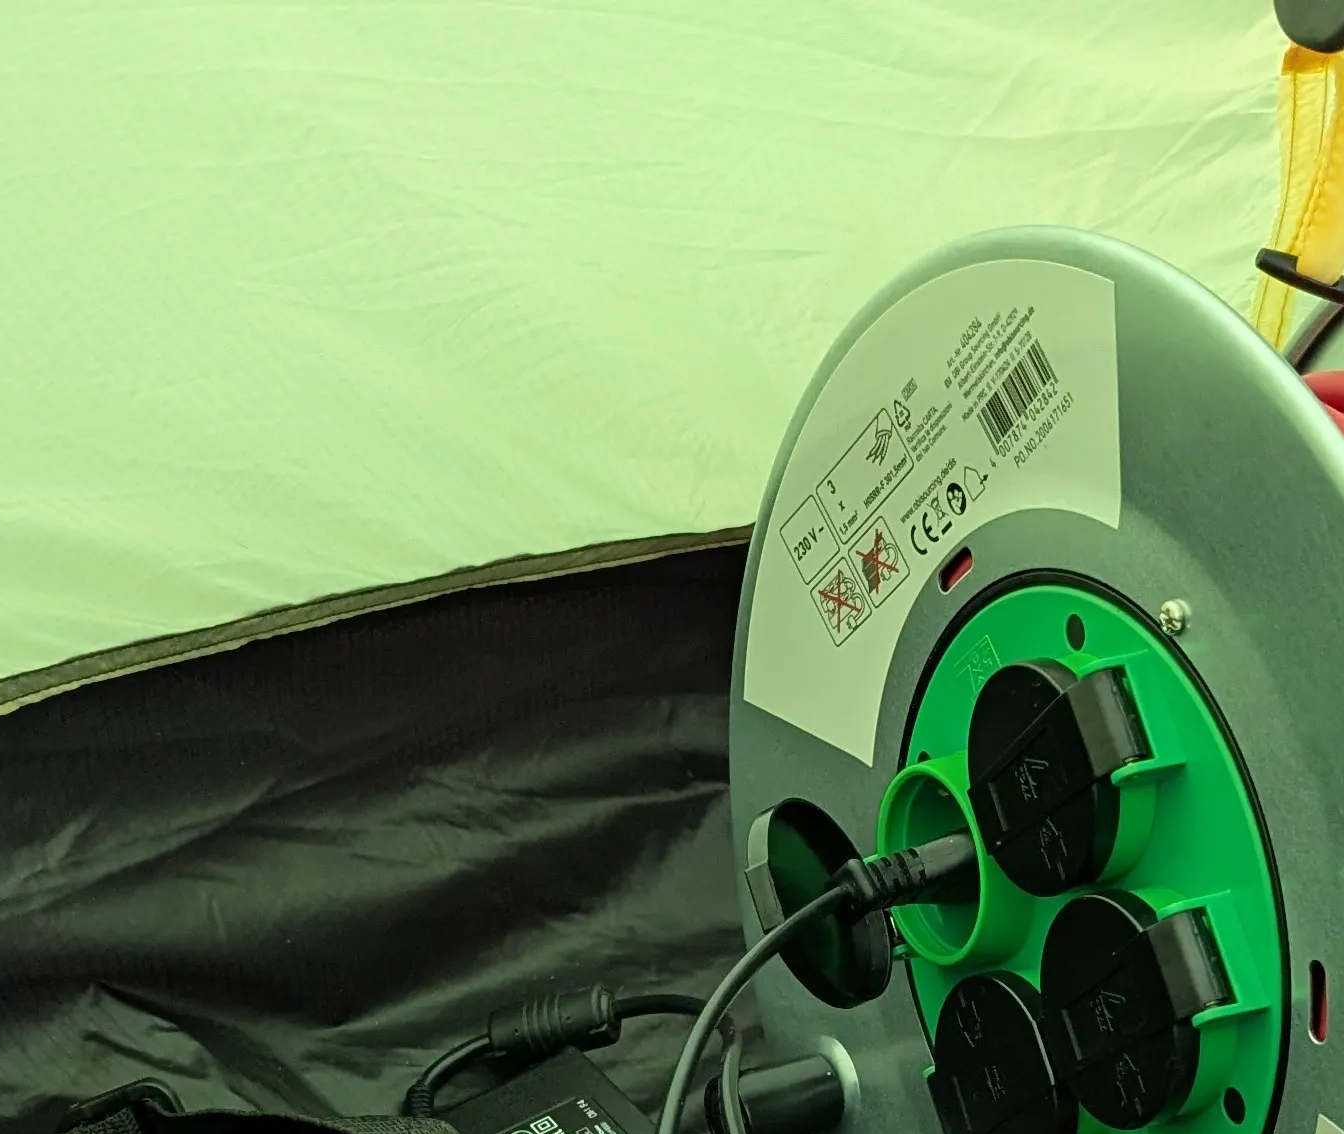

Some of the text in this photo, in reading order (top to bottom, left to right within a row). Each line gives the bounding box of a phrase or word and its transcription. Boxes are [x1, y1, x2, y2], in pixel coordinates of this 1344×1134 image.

[998, 420, 1027, 457] 007874
[1028, 382, 1058, 421] 042842
[827, 480, 836, 494] 3
[794, 536, 812, 561] 230
[808, 527, 818, 543] V
